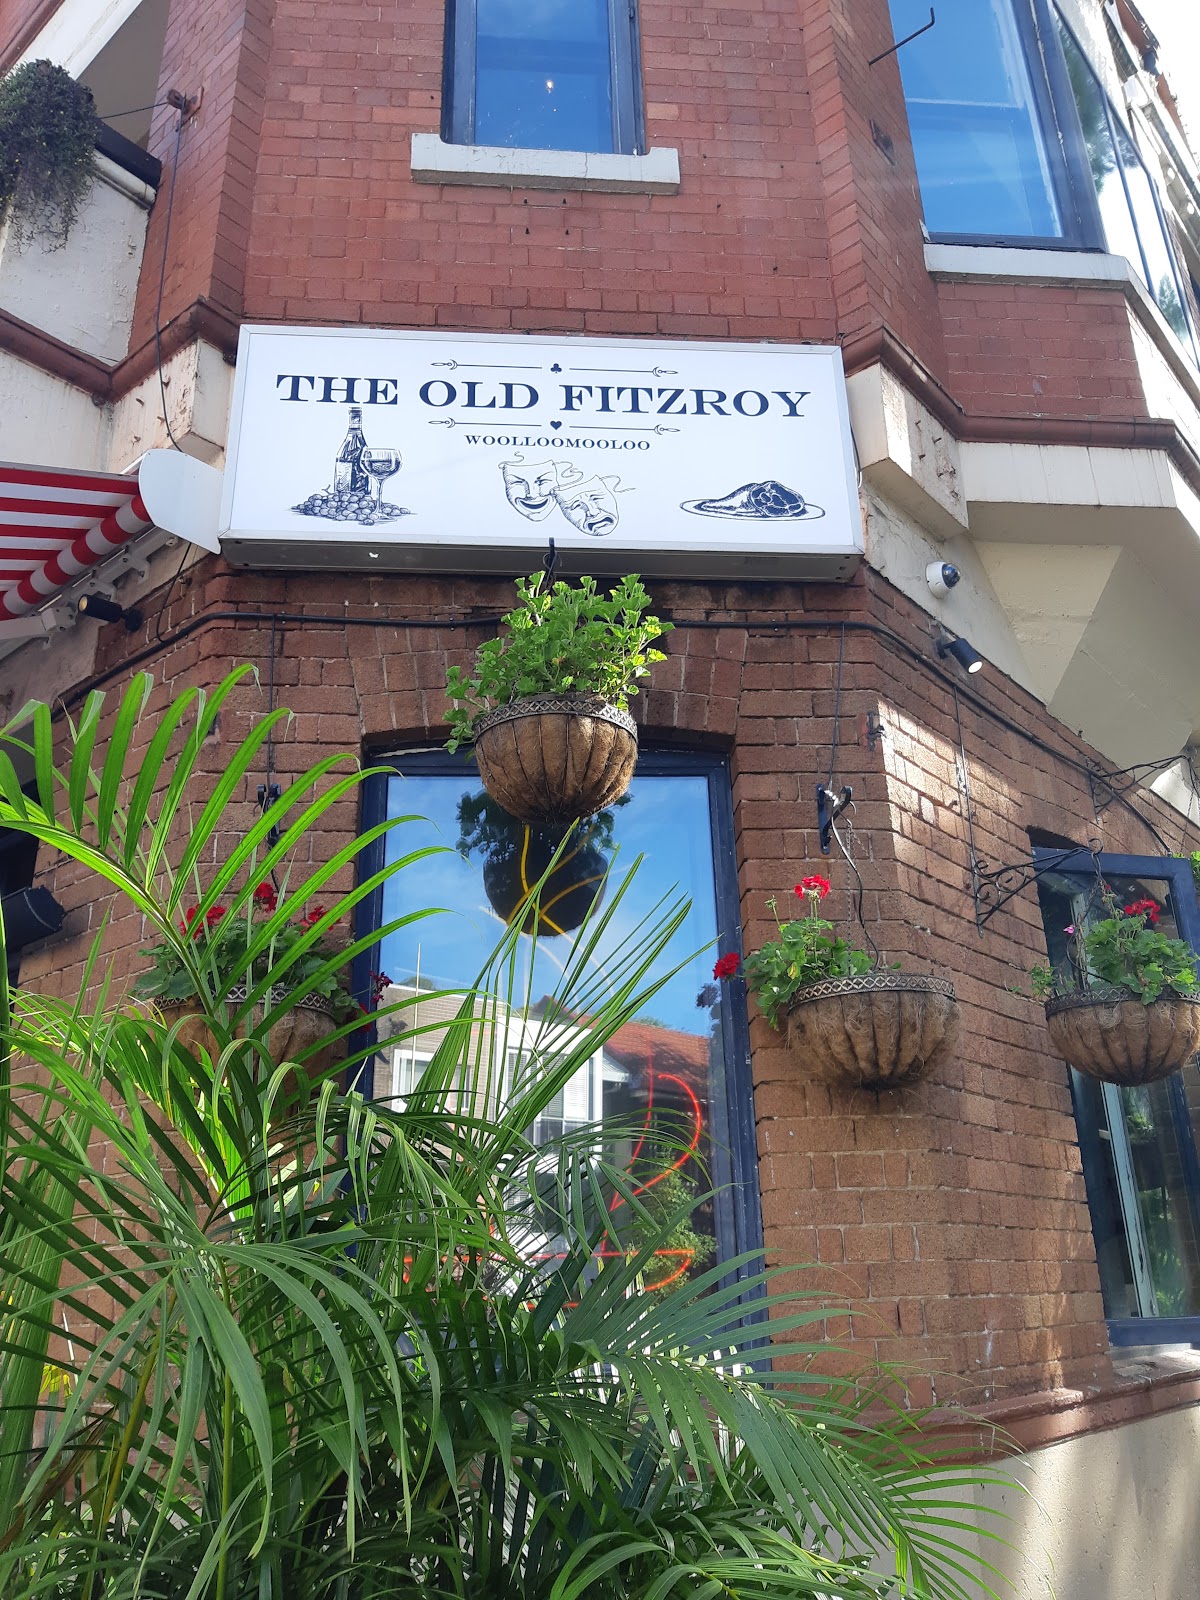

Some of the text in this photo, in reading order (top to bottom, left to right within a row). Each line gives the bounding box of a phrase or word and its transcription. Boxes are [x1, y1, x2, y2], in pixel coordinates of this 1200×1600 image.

[276, 374, 811, 418] THE OLD FITZROY
[465, 435, 650, 451] WOOLLOOMOOLOO
